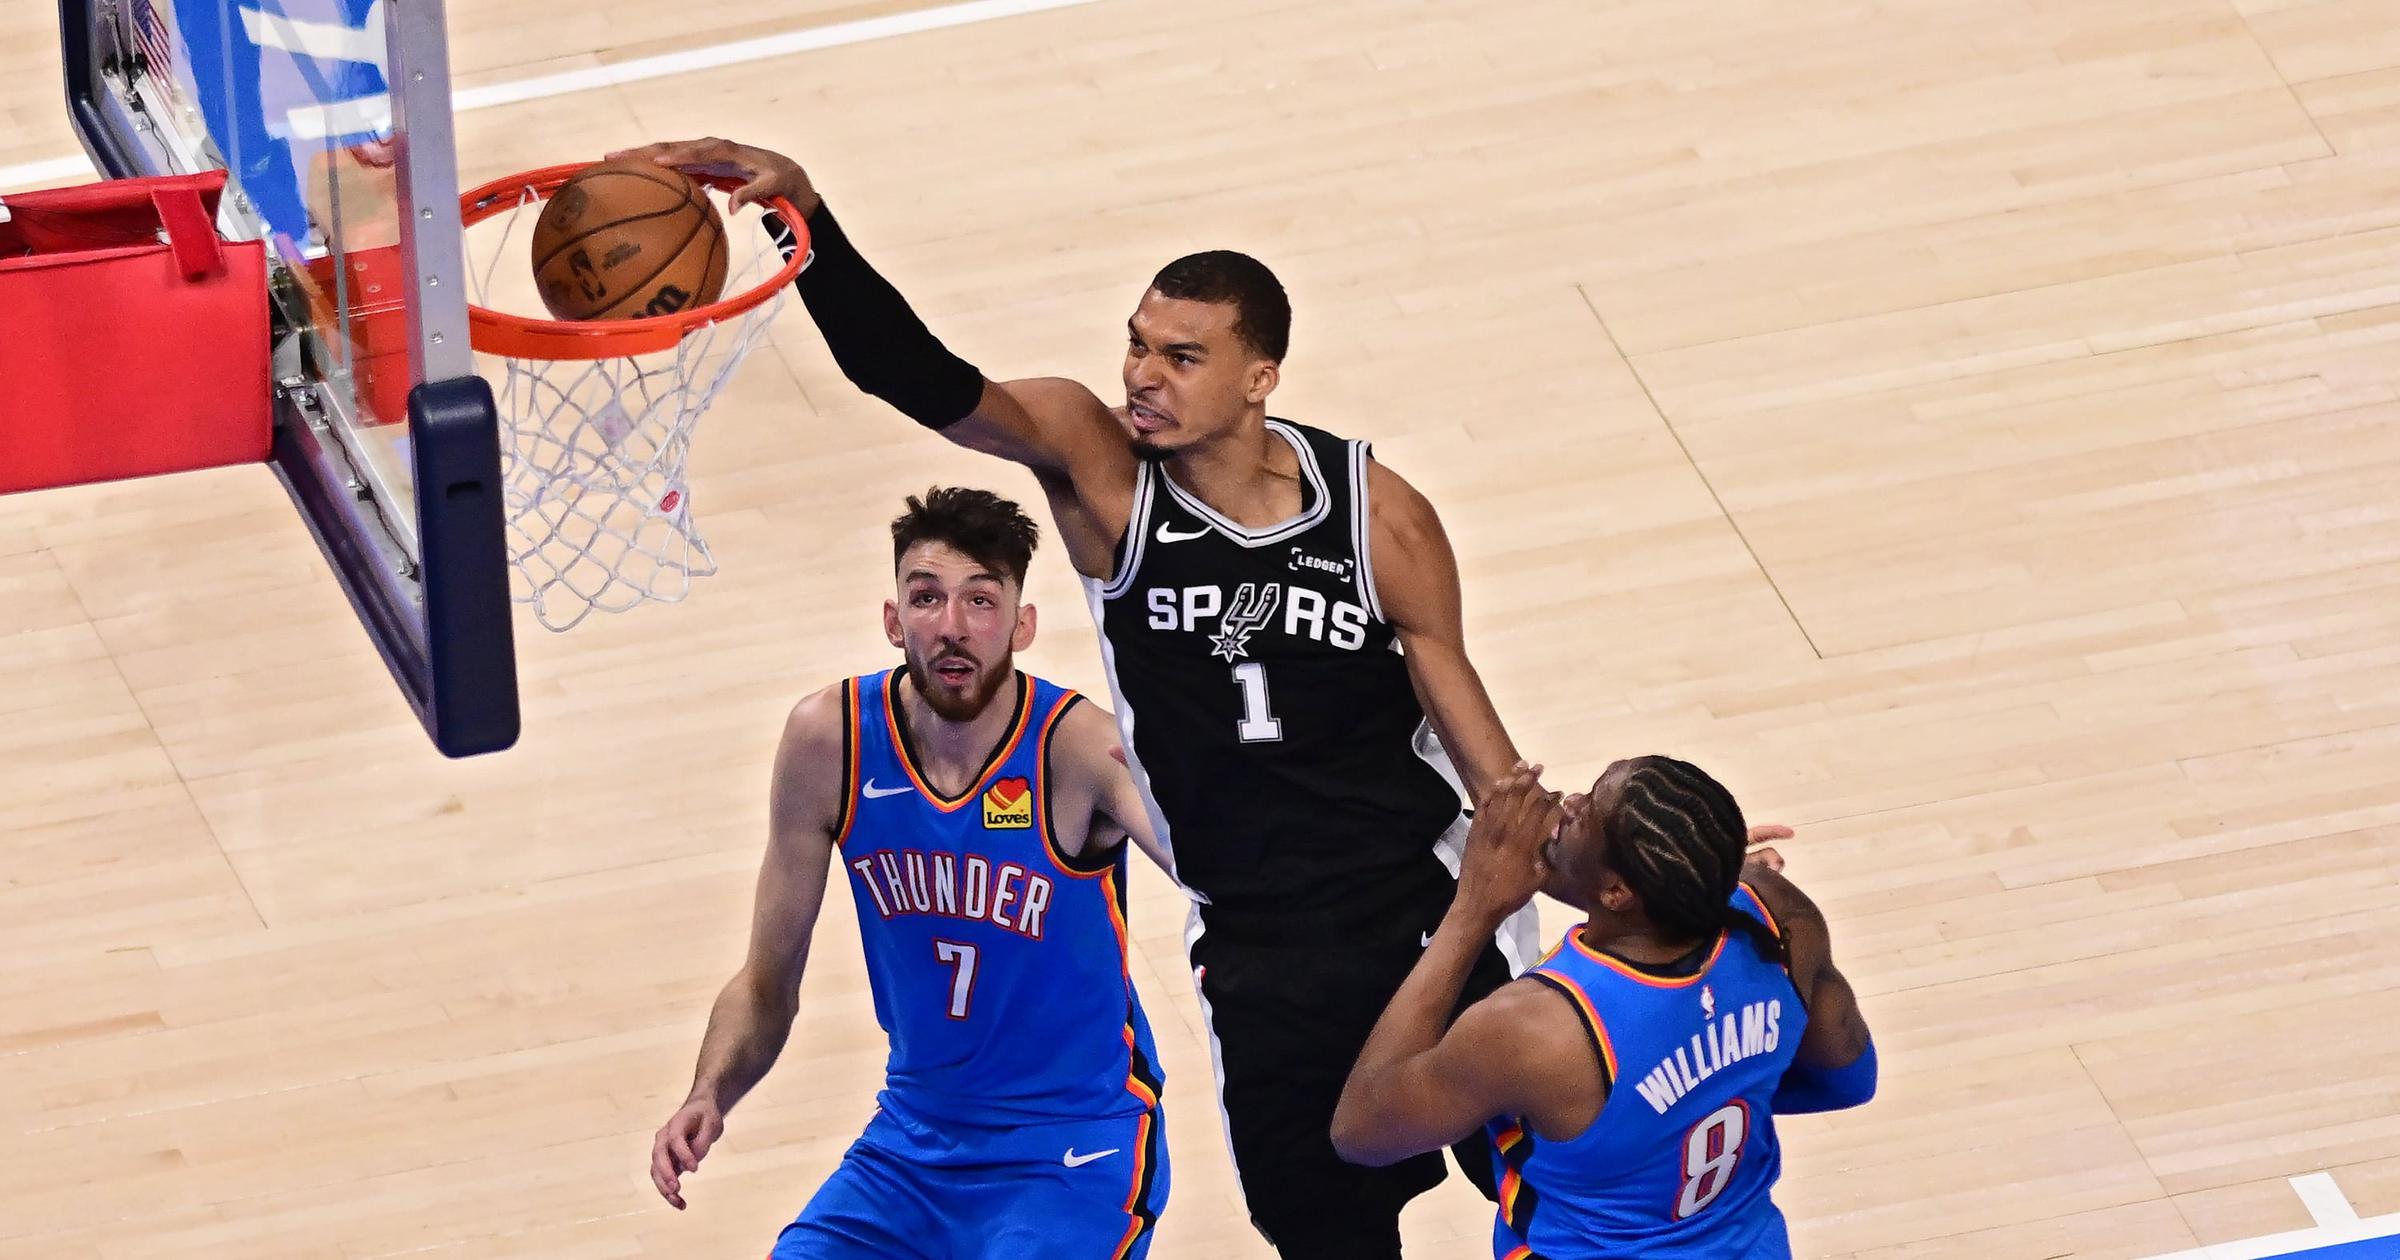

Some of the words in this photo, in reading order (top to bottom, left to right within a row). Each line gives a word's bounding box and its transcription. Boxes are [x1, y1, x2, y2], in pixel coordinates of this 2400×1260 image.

[1297, 554, 1345, 575] LEDGER
[1232, 661, 1283, 743] 1
[853, 849, 1053, 941] THUNDER
[932, 938, 980, 1021] 7
[1635, 1000, 1781, 1115] WILLIAMS
[1671, 1097, 1751, 1222] 8
